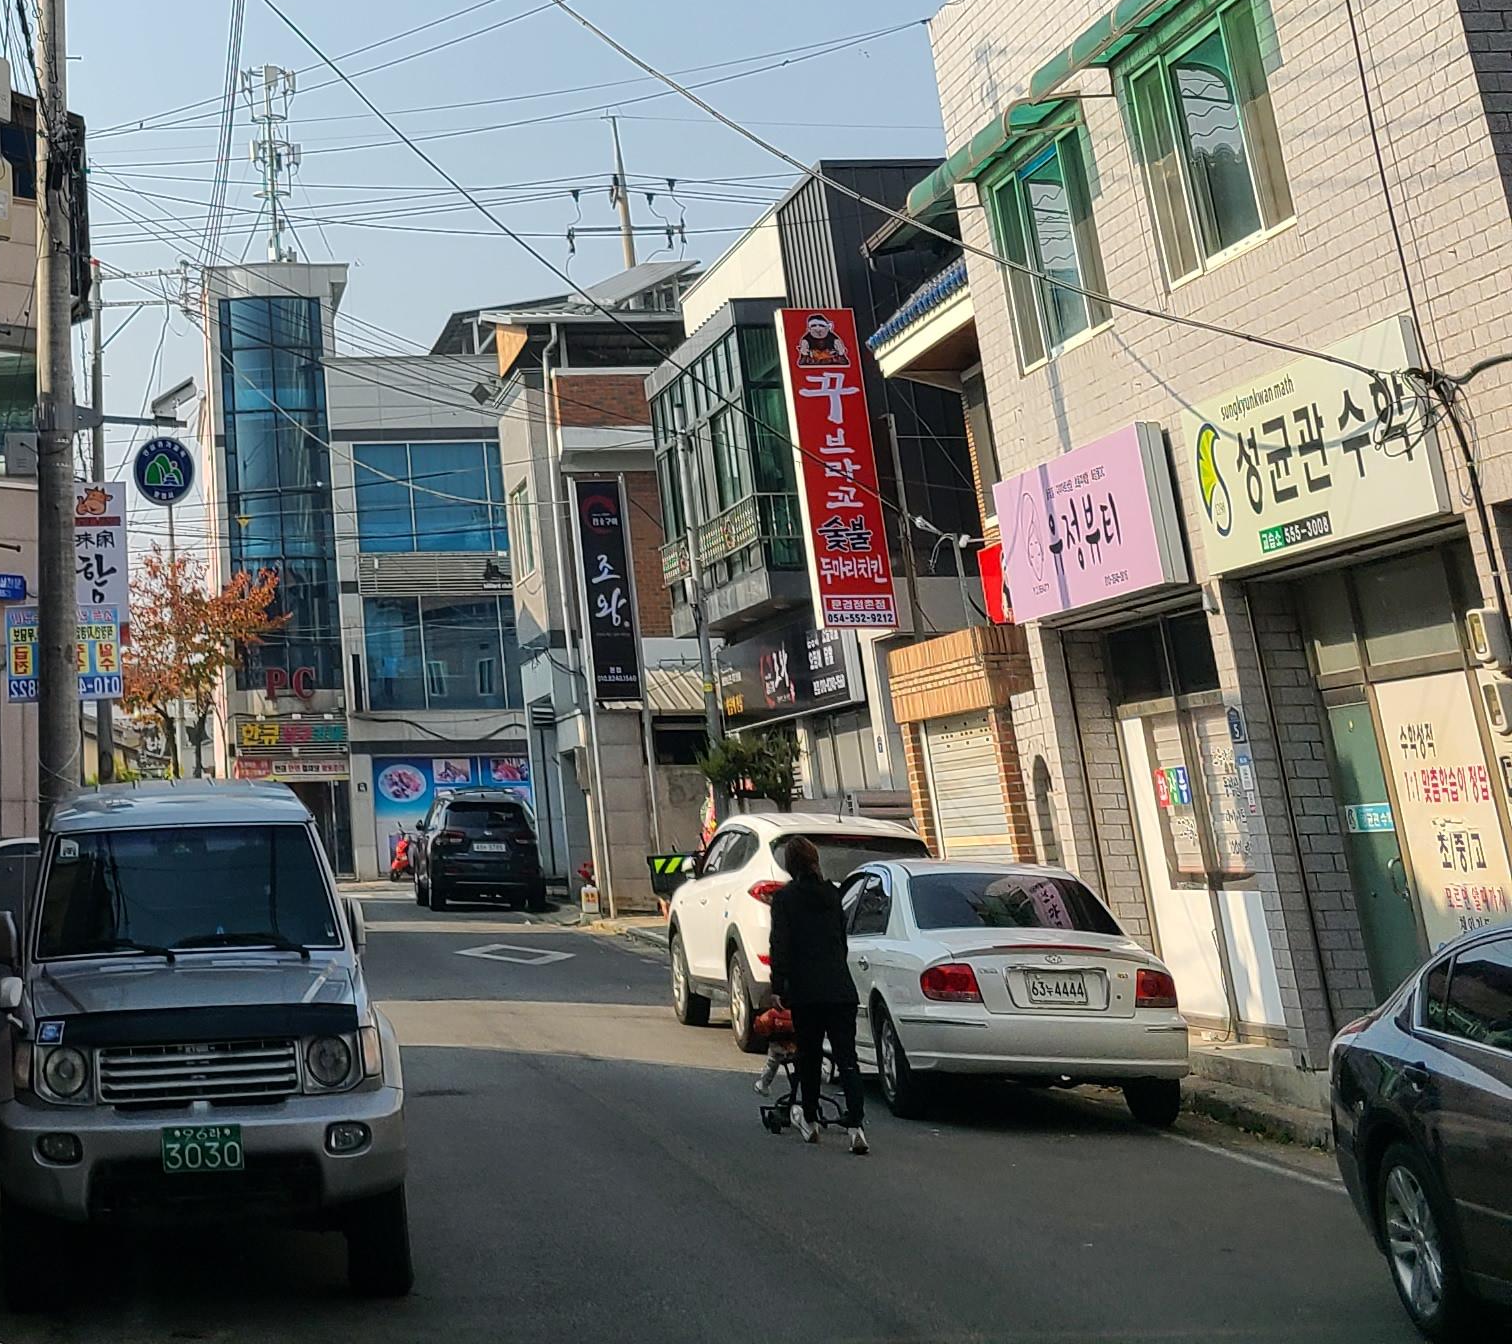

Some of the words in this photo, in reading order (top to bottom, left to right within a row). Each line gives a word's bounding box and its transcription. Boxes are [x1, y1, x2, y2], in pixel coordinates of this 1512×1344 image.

[1273, 373, 1295, 400] math
[1236, 402, 1333, 515] 성균관
[1338, 374, 1414, 478] 수학
[817, 515, 873, 552] 숯불
[1048, 492, 1122, 576] 유정뷰티
[1262, 533, 1284, 551] 교습소
[1284, 516, 1329, 545] 555-3008
[820, 554, 888, 585] 두마리치킨
[828, 613, 893, 623] 054-552-9212
[265, 666, 317, 703] PC
[1399, 722, 1437, 760] 수학성적
[1469, 764, 1490, 804] 정답
[1445, 887, 1470, 911] 모르면
[1032, 980, 1085, 999] 63누4444
[183, 1127, 221, 1143] 96라
[166, 1141, 241, 1169] 3030
